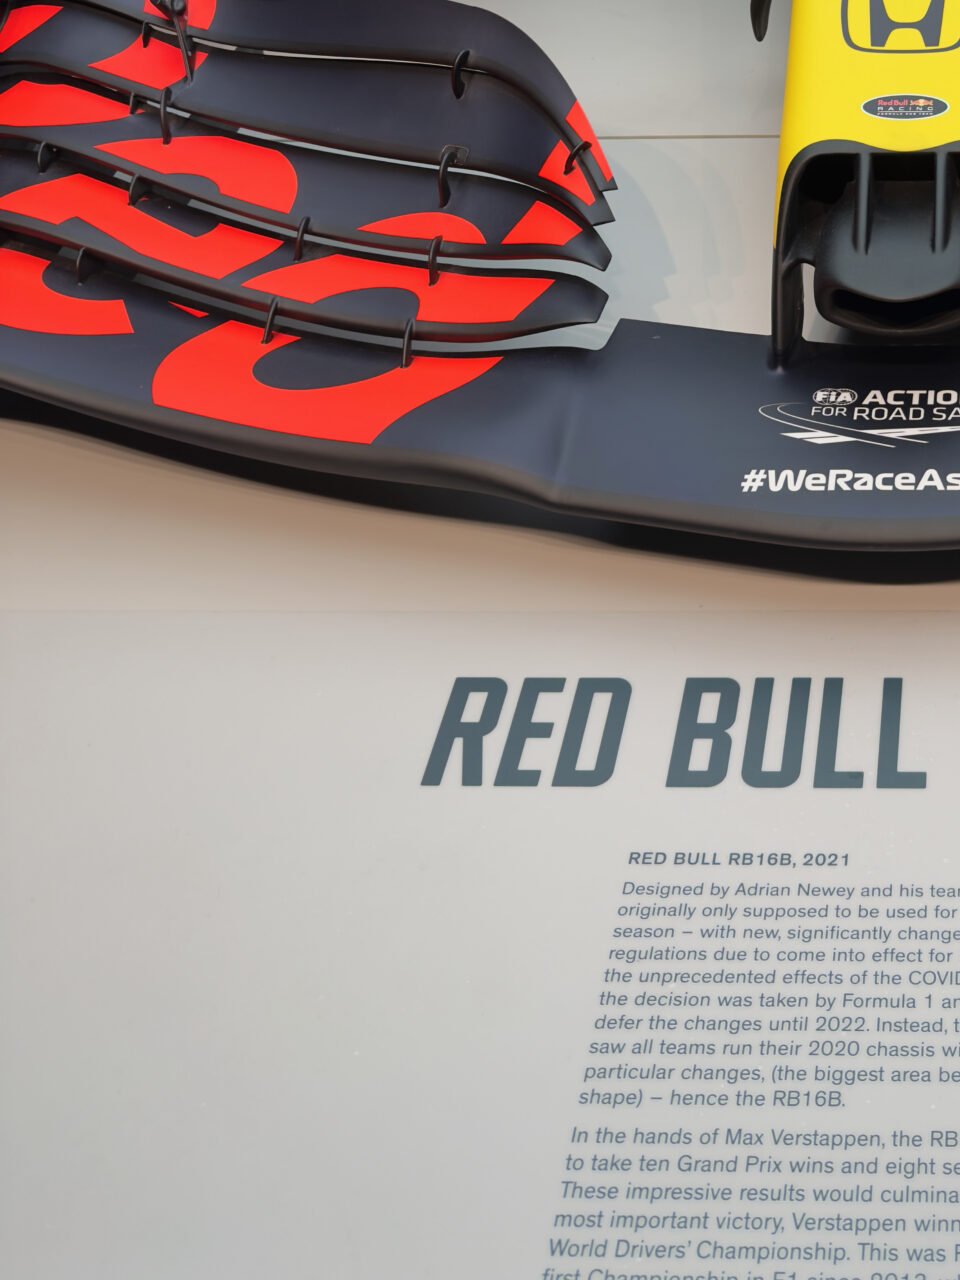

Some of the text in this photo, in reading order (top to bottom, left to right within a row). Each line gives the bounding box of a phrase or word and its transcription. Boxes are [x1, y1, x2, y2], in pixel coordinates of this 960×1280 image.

[811, 406, 847, 417] FOR
[853, 406, 925, 421] ROAD
[420, 675, 633, 788] RED
[665, 675, 927, 789] BULL
[627, 851, 849, 869] RED BULL RB16B, 2021
[621, 881, 705, 899] Designed
[709, 882, 731, 900] by
[734, 882, 791, 897] Adrian
[797, 882, 856, 901] Newey
[860, 883, 893, 898] and
[899, 883, 924, 898] his
[617, 902, 697, 921] originally
[701, 903, 738, 921] only
[742, 904, 829, 921] supposed
[834, 904, 852, 918] to
[858, 904, 880, 919] be
[886, 904, 928, 919] used
[933, 904, 958, 919] for
[612, 927, 675, 939] season
[699, 924, 737, 939] with
[742, 928, 782, 942] new,
[787, 925, 892, 944] significantly
[608, 945, 707, 964] regulations
[713, 946, 748, 962] due
[753, 947, 771, 962] to
[776, 950, 826, 962] come
[832, 947, 866, 962] into
[871, 947, 923, 963] effect
[928, 948, 953, 963] for
[603, 967, 633, 983] the
[638, 969, 777, 987] unprecedented
[782, 969, 844, 985] effects
[849, 969, 869, 985] of
[872, 970, 902, 986] the
[594, 1014, 644, 1030] defer
[648, 1014, 678, 1031] the
[684, 1015, 762, 1035] changes
[769, 1016, 809, 1032] until
[815, 1016, 870, 1032] 2022.
[876, 1016, 948, 1035] Instead,
[583, 1063, 676, 1083] particular
[680, 1064, 765, 1085] changes,
[771, 1064, 807, 1084] (the
[814, 1065, 885, 1086] biggest
[890, 1070, 932, 1083] area
[570, 1126, 589, 1144] In
[595, 1127, 627, 1144] the
[632, 1127, 693, 1145] hands
[699, 1127, 720, 1145] of
[725, 1127, 764, 1146] Max
[771, 1128, 886, 1151] Verstappen,
[891, 1129, 923, 1148] the
[565, 1153, 585, 1171] to
[591, 1153, 633, 1172] take
[639, 1154, 670, 1172] ten
[677, 1154, 739, 1173] Grand
[745, 1155, 782, 1173] Prix
[789, 1156, 835, 1174] wins
[840, 1156, 879, 1175] and
[885, 1157, 936, 1180] eight
[561, 1180, 619, 1200] These
[625, 1182, 733, 1204] impressive
[739, 1183, 806, 1202] results
[812, 1184, 873, 1203] would
[553, 1210, 604, 1228] most
[609, 1210, 710, 1233] important
[716, 1211, 785, 1235] victory,
[792, 1212, 906, 1236] Verstappen
[549, 1238, 609, 1258] World
[614, 1239, 692, 1259] Drivers’
[696, 1240, 851, 1266] Championship.
[857, 1242, 899, 1262] This
[905, 1247, 947, 1263] was
